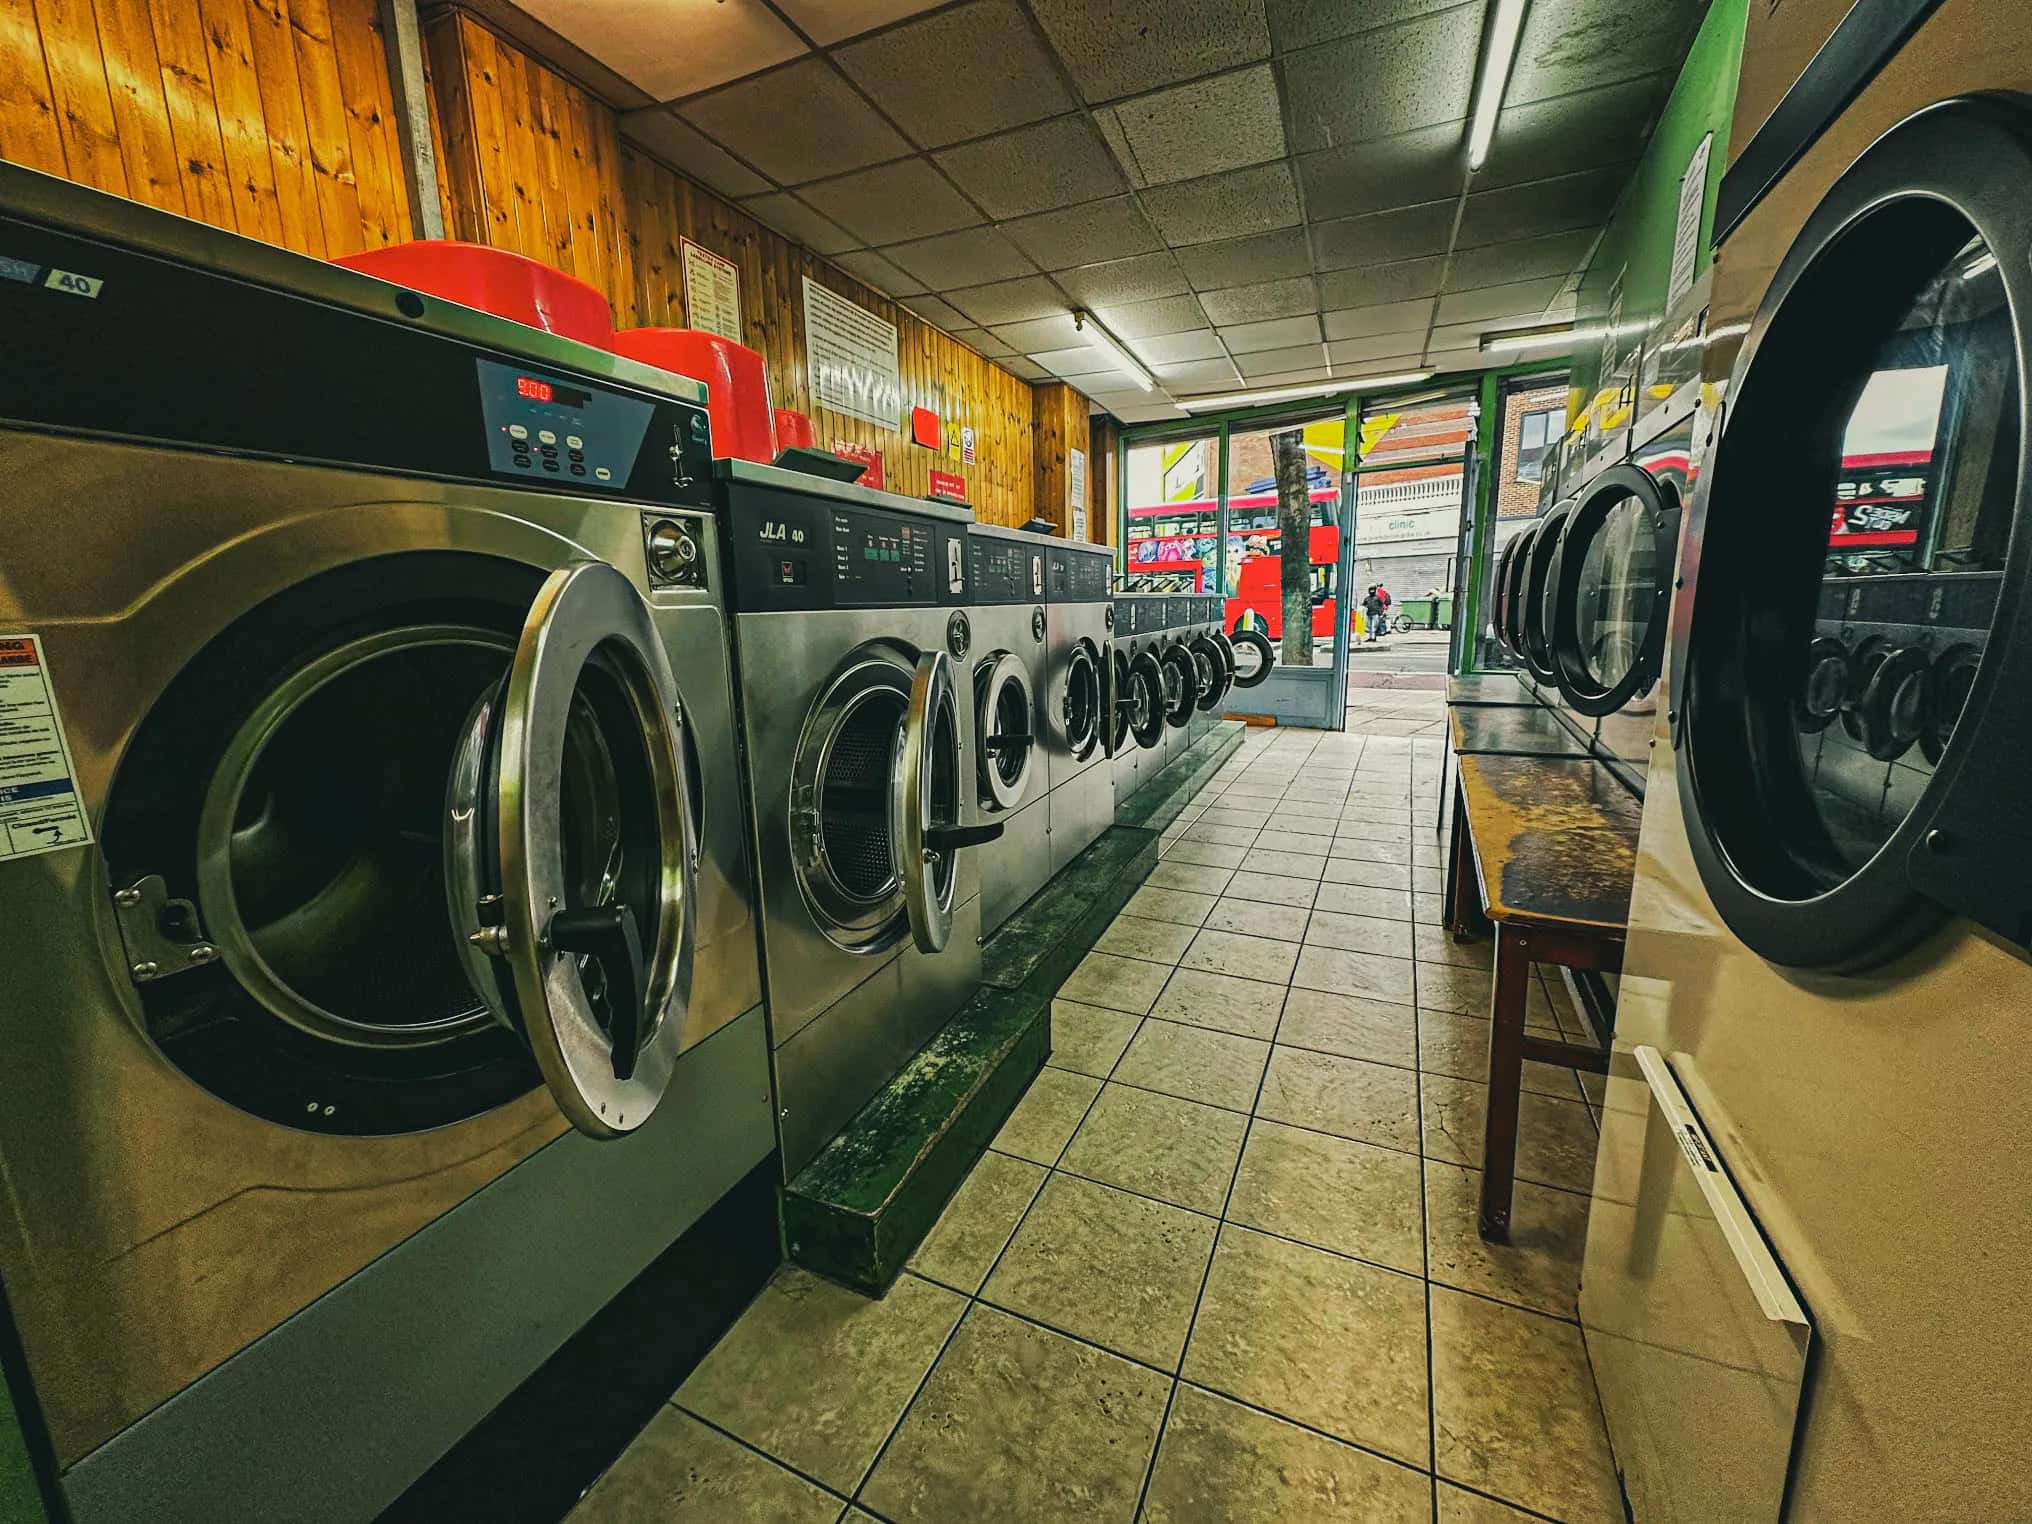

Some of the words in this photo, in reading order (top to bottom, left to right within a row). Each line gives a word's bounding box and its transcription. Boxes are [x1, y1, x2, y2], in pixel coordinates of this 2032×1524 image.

[60, 274, 91, 294] 40
[759, 521, 787, 541] JLA
[791, 529, 805, 543] 40
[1388, 519, 1416, 530] clinic
